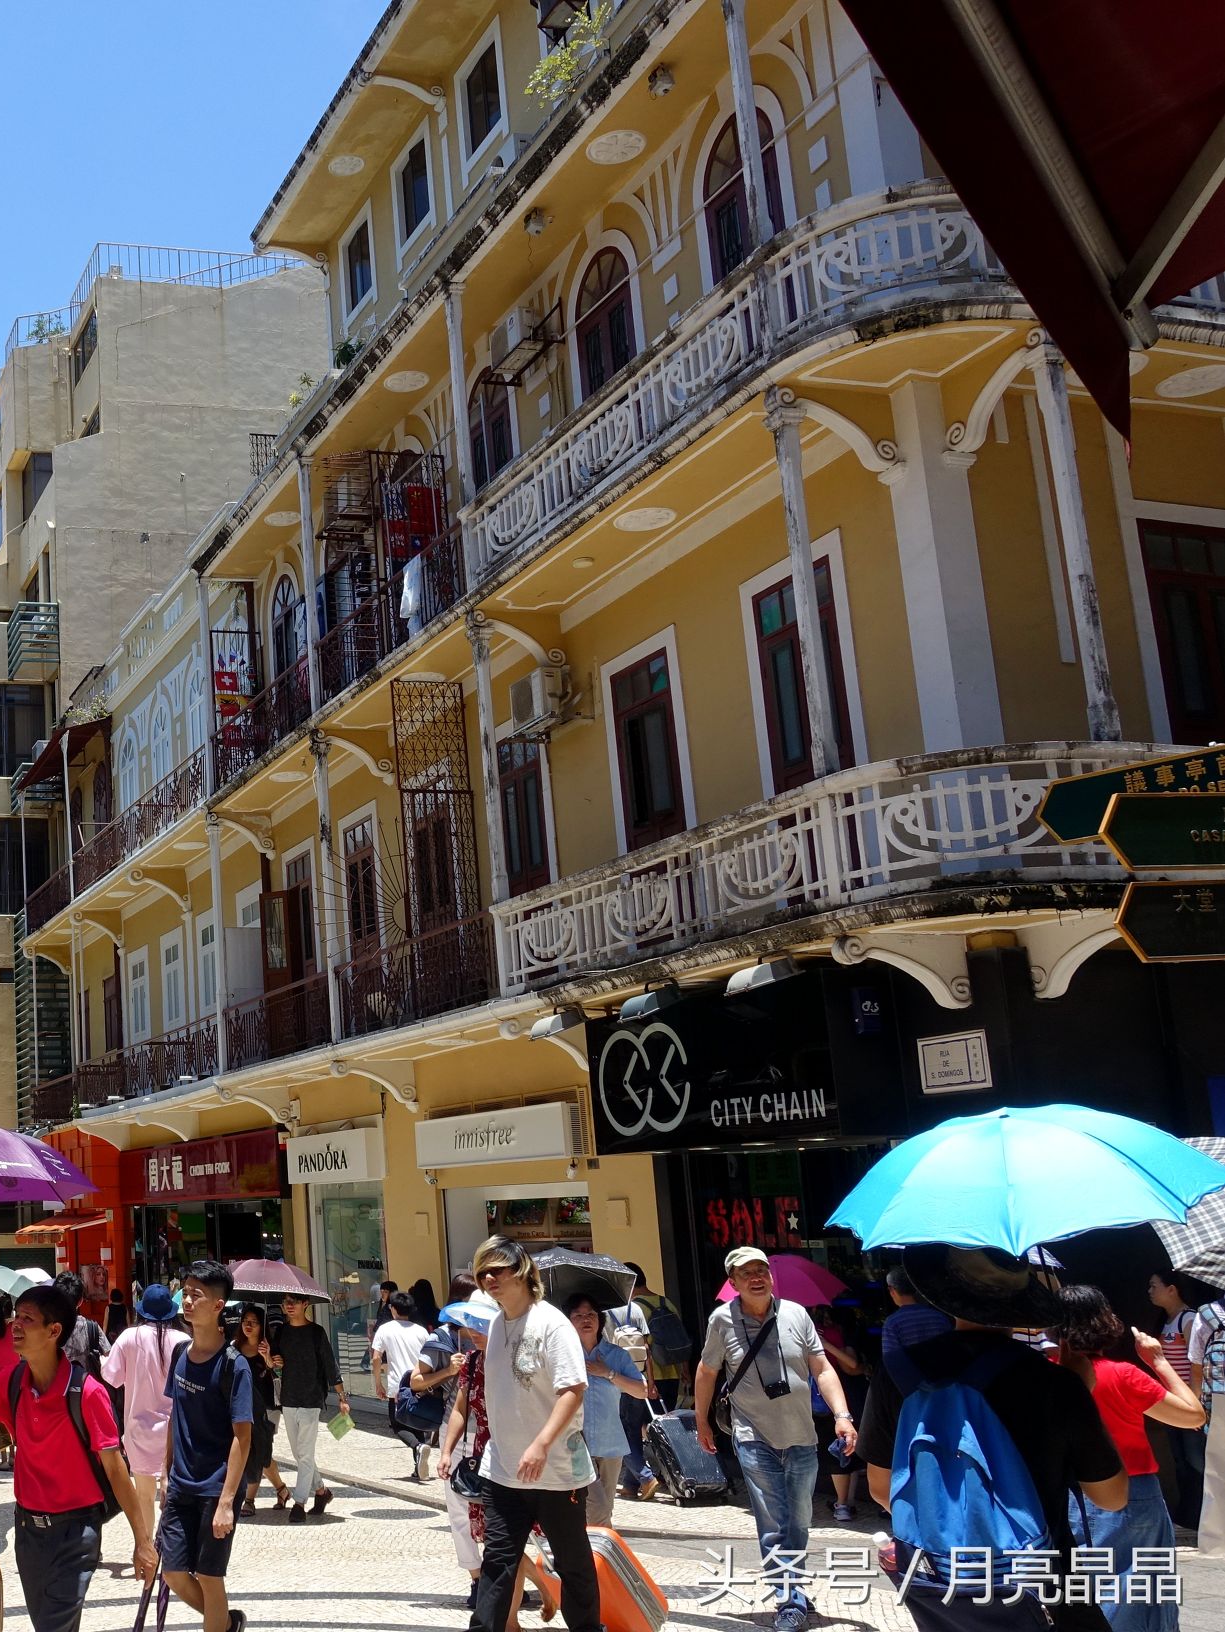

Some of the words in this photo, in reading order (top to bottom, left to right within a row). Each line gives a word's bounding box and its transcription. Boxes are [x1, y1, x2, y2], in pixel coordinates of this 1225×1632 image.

[1173, 889, 1217, 912] 大堂
[710, 1097, 753, 1127] CITY
[760, 1088, 826, 1123] CHAIN
[454, 1121, 513, 1151] innisfree
[148, 1155, 184, 1192] 周大福
[189, 1165, 204, 1177] CHOW
[214, 1161, 230, 1174] FOOK
[298, 1149, 348, 1174] PANDORA
[707, 1196, 802, 1248] SALE
